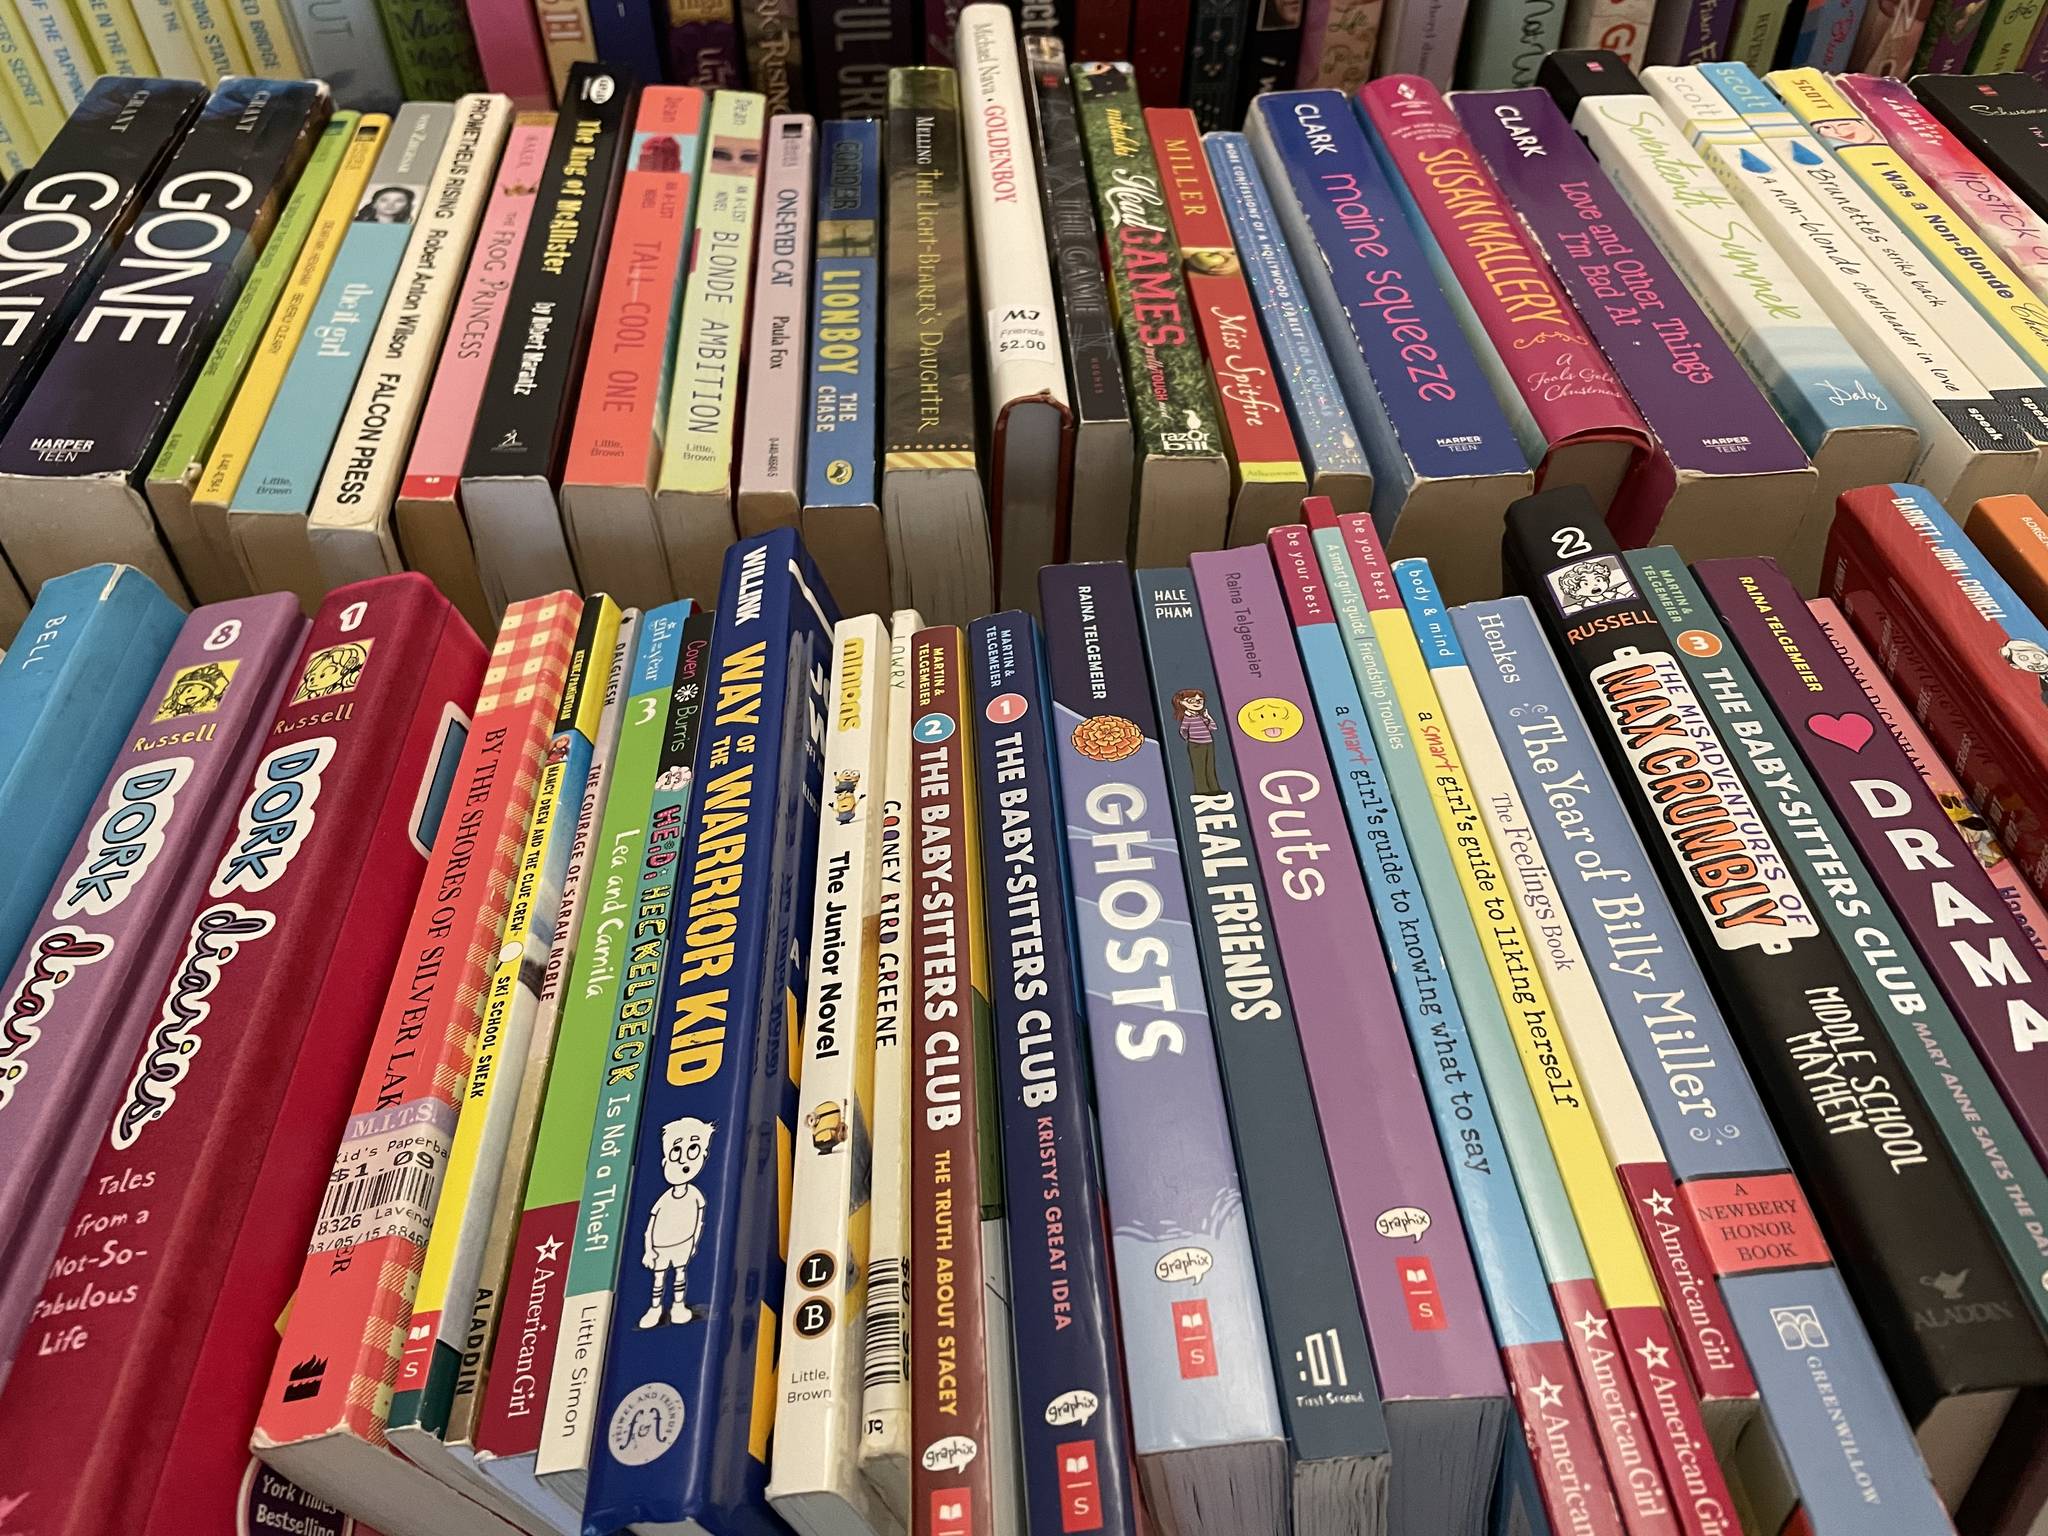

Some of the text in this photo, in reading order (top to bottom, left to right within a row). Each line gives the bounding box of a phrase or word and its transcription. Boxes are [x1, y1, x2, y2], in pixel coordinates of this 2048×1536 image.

[1494, 105, 1547, 158] CLARK
[1666, 74, 1723, 117] scott
[1716, 68, 1772, 110] scott
[1792, 79, 1834, 110] SCOTT
[385, 98, 491, 358] PROMETHEUS RISING Robert Wilson
[772, 190, 798, 256] ONE-EYED
[1418, 148, 1503, 220] SUSAN
[75, 171, 253, 344] GONE
[705, 231, 739, 305] BLONDE
[770, 257, 793, 288] CAT
[1294, 103, 1339, 157] CLARK
[1321, 173, 1389, 259] maine
[1358, 269, 1457, 402] squeeze
[1459, 220, 1570, 326] MALLERY
[1807, 168, 1944, 308] Brunettes strike back
[1881, 169, 1917, 198] Was
[1922, 213, 2015, 299] Non-Blonde
[817, 270, 862, 376] LIONBOY
[1120, 226, 1186, 346] GAMES
[1165, 139, 1280, 427] MILLER Miss Spitfire
[1557, 232, 1642, 327] I'm Bad At
[1560, 181, 1715, 386] Love and Other Things
[1771, 187, 1960, 393] non-blonde cheerleader in love
[602, 302, 649, 413] COOL ONE
[688, 318, 730, 435] AMBITION
[769, 350, 784, 371] Fox
[771, 315, 790, 349] Paula
[999, 338, 1047, 354] $2.00
[30, 438, 95, 451] HARPER
[337, 372, 402, 505] FALCON PRESS
[815, 384, 837, 434] CHASE
[837, 391, 858, 423] THE
[1162, 440, 1208, 451] bill
[1436, 435, 1483, 447] HARPER
[1702, 435, 1752, 447] HARPER
[1967, 407, 2004, 442] speak
[37, 451, 78, 463] TEEN
[735, 545, 767, 627] WILLINK
[1155, 589, 1188, 602] HALE
[1302, 584, 1322, 616] best
[1891, 497, 2008, 622] BARNETT CORNELL
[22, 615, 67, 670] BELL
[1001, 629, 1014, 668] MARTIN
[1078, 585, 1107, 700] RAINA TELGEMEIER
[1155, 606, 1193, 619] PHAM
[1225, 572, 1262, 679] Raina Telgemeier
[1408, 569, 1456, 658] body mind
[1477, 613, 1521, 685] Henkes
[1567, 609, 1658, 646] RUSSELL
[1738, 575, 1825, 694] RAINA TELGEMEIER
[932, 647, 944, 687] MARTIN
[132, 723, 218, 753] Russell
[273, 703, 355, 736] Russell
[67, 768, 177, 906] DORK
[666, 641, 766, 1087] WAY OF THE WARRIOR KID
[1190, 791, 1249, 878] REAL
[1259, 769, 1331, 901] Guts
[1638, 746, 1787, 930] CRUMBLY
[1701, 666, 1927, 1016] THE BABY-SITTERS CLUB
[401, 727, 508, 1043] BY SHORES OF SILVER
[995, 731, 1058, 1109] THE BABY-SITTERS CLUB
[1085, 782, 1186, 1062] GHOSTS
[1492, 792, 1573, 972] The Book
[1518, 714, 1718, 1120] The Year of Billy Miller
[1849, 778, 2048, 1053] DRAMA
[119, 748, 321, 1141] DORK diaries
[541, 950, 564, 1002] NOBLE
[815, 851, 850, 1060] The Junior Novel
[919, 747, 962, 1131] THE BABY-SITTERS CLUB
[1458, 836, 1579, 1110] guide to liking herself
[1368, 830, 1492, 1176] guide to knowing what to say
[1786, 1030, 1870, 1135] MAYHEM
[1805, 986, 1929, 1175] MIDDLE SCHOOL
[1912, 1021, 2035, 1217] MARY ANNE SAVES THE
[74, 1213, 128, 1239] from
[99, 1168, 156, 1196] Tales
[317, 1213, 362, 1236] 8326
[1378, 1212, 1428, 1237] graphix
[1044, 1205, 1072, 1332] GREAT IDEA
[1159, 1253, 1210, 1280] graphix
[1722, 1220, 1796, 1242] HONOR
[1738, 1243, 1799, 1263] BOOK
[934, 1150, 958, 1417] THE TRUTH ABOUT STACEY
[38, 1325, 89, 1356] Life
[456, 1288, 493, 1396] ALADDIN
[561, 1305, 599, 1438] Little Simon
[787, 1387, 832, 1404] Brown
[1048, 1395, 1097, 1424] graphix
[1806, 1356, 1881, 1506] GREENWILLOW
[925, 1441, 975, 1464] graphix
